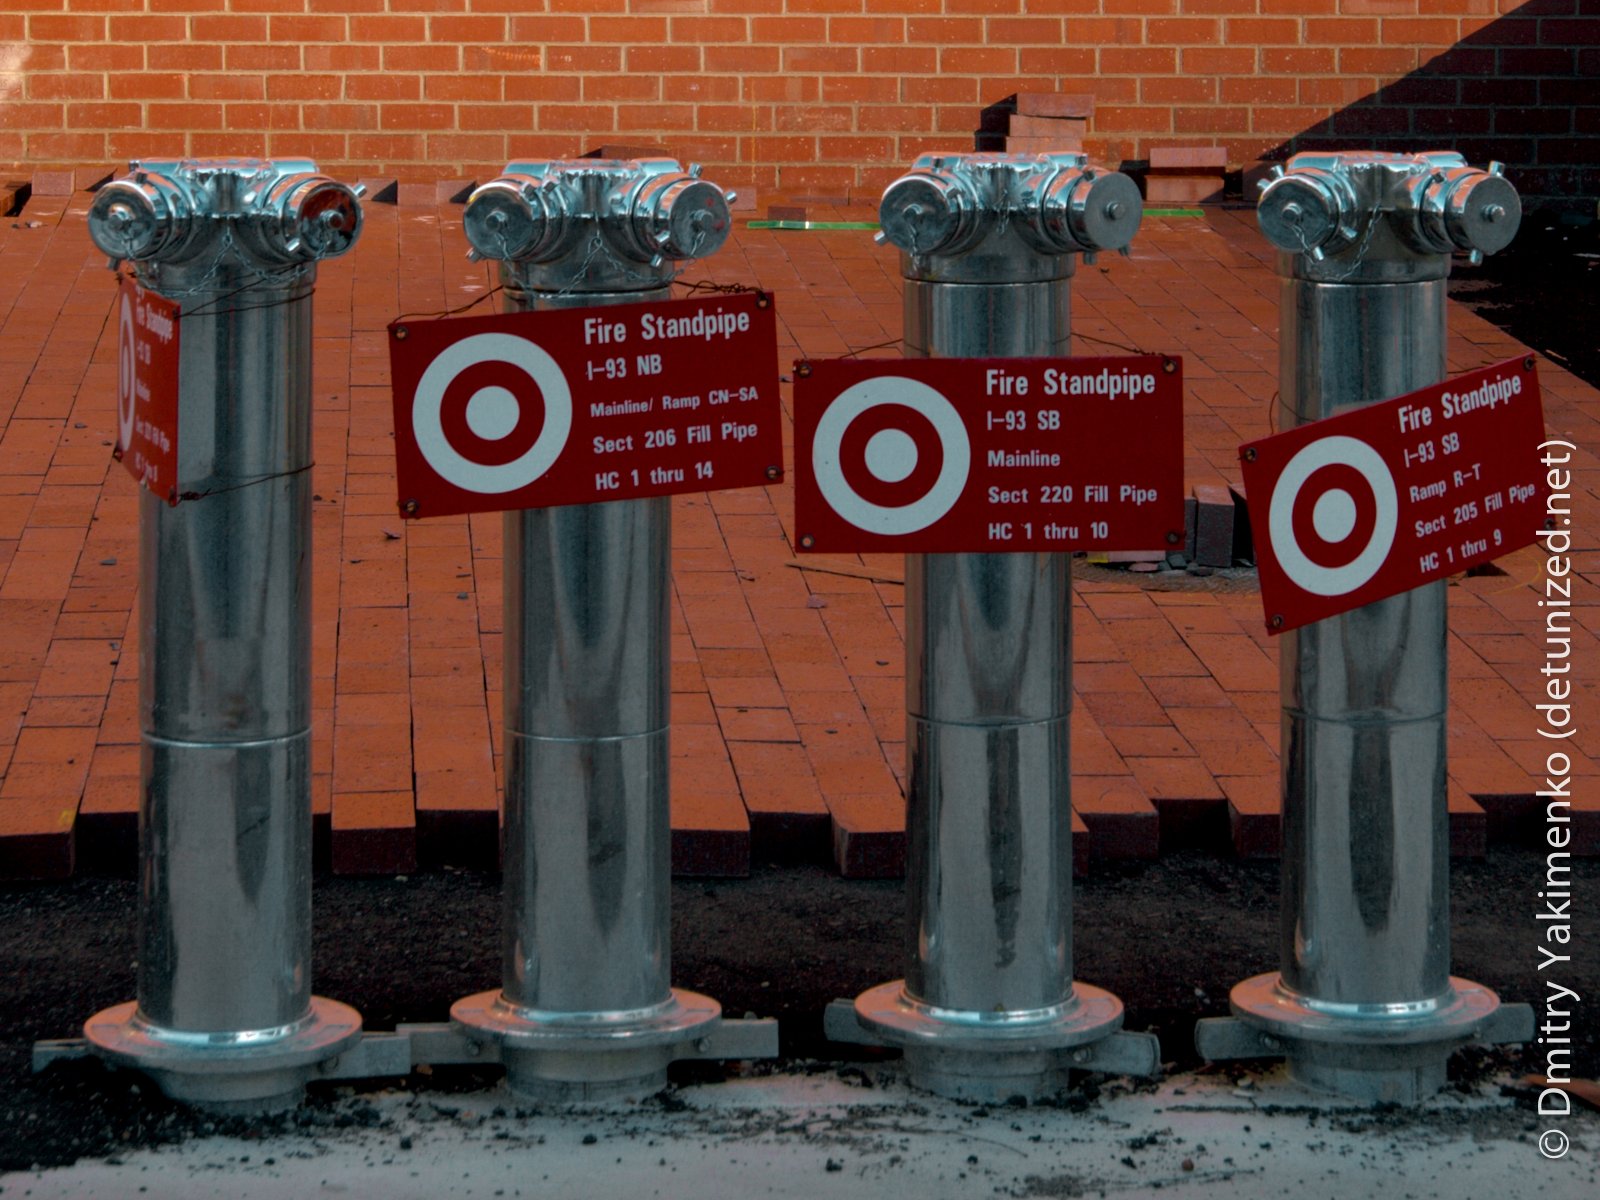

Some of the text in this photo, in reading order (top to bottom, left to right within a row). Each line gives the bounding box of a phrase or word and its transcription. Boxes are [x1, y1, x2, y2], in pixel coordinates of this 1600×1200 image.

[585, 308, 749, 344] Fire Standpipe
[588, 354, 662, 380] I-93 NB
[663, 396, 700, 409] Ramp
[709, 387, 758, 404] CN-SA
[987, 368, 1155, 400] Fire Standpipe
[1398, 375, 1521, 433] Fire Standpipe
[987, 410, 1060, 430] I-93 SB
[593, 422, 757, 453] Sect 206 Fill Pipe
[1404, 432, 1459, 467] I-93 SB
[988, 450, 1060, 466] Mainline
[596, 461, 713, 490] HC 1 thru 14
[1410, 464, 1480, 502] Ramp R-T
[989, 485, 1157, 505] Sect 220 Fill Pipe
[1415, 484, 1534, 537] Sect 205 Fill Pipe
[989, 522, 1108, 539] HC 1 thru 10
[1420, 529, 1501, 572] HC 1 thru 9
